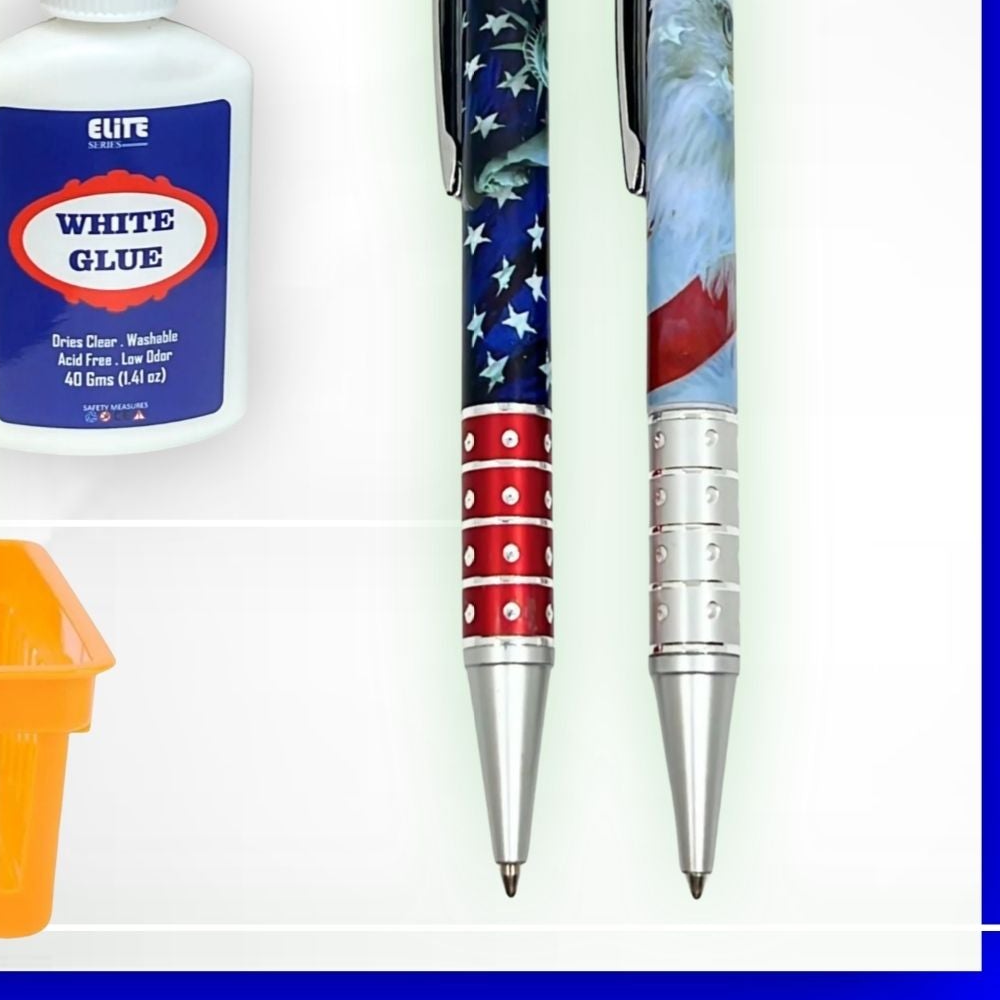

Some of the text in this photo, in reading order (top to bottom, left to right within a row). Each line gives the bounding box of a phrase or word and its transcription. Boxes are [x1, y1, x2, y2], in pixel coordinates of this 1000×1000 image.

[88, 141, 122, 149] SERIES
[55, 208, 174, 235] WHITE
[69, 246, 162, 272] GLUE
[52, 333, 83, 348] Dries
[86, 334, 118, 348] Clear
[126, 329, 178, 347] Washable
[58, 352, 83, 366] Acid
[86, 353, 112, 366] Free
[121, 352, 143, 366] Low
[146, 349, 173, 363] Odor
[64, 367, 167, 387] 40 Gms (1.41 oz)
[83, 402, 149, 412] SAFETY MEASURES
